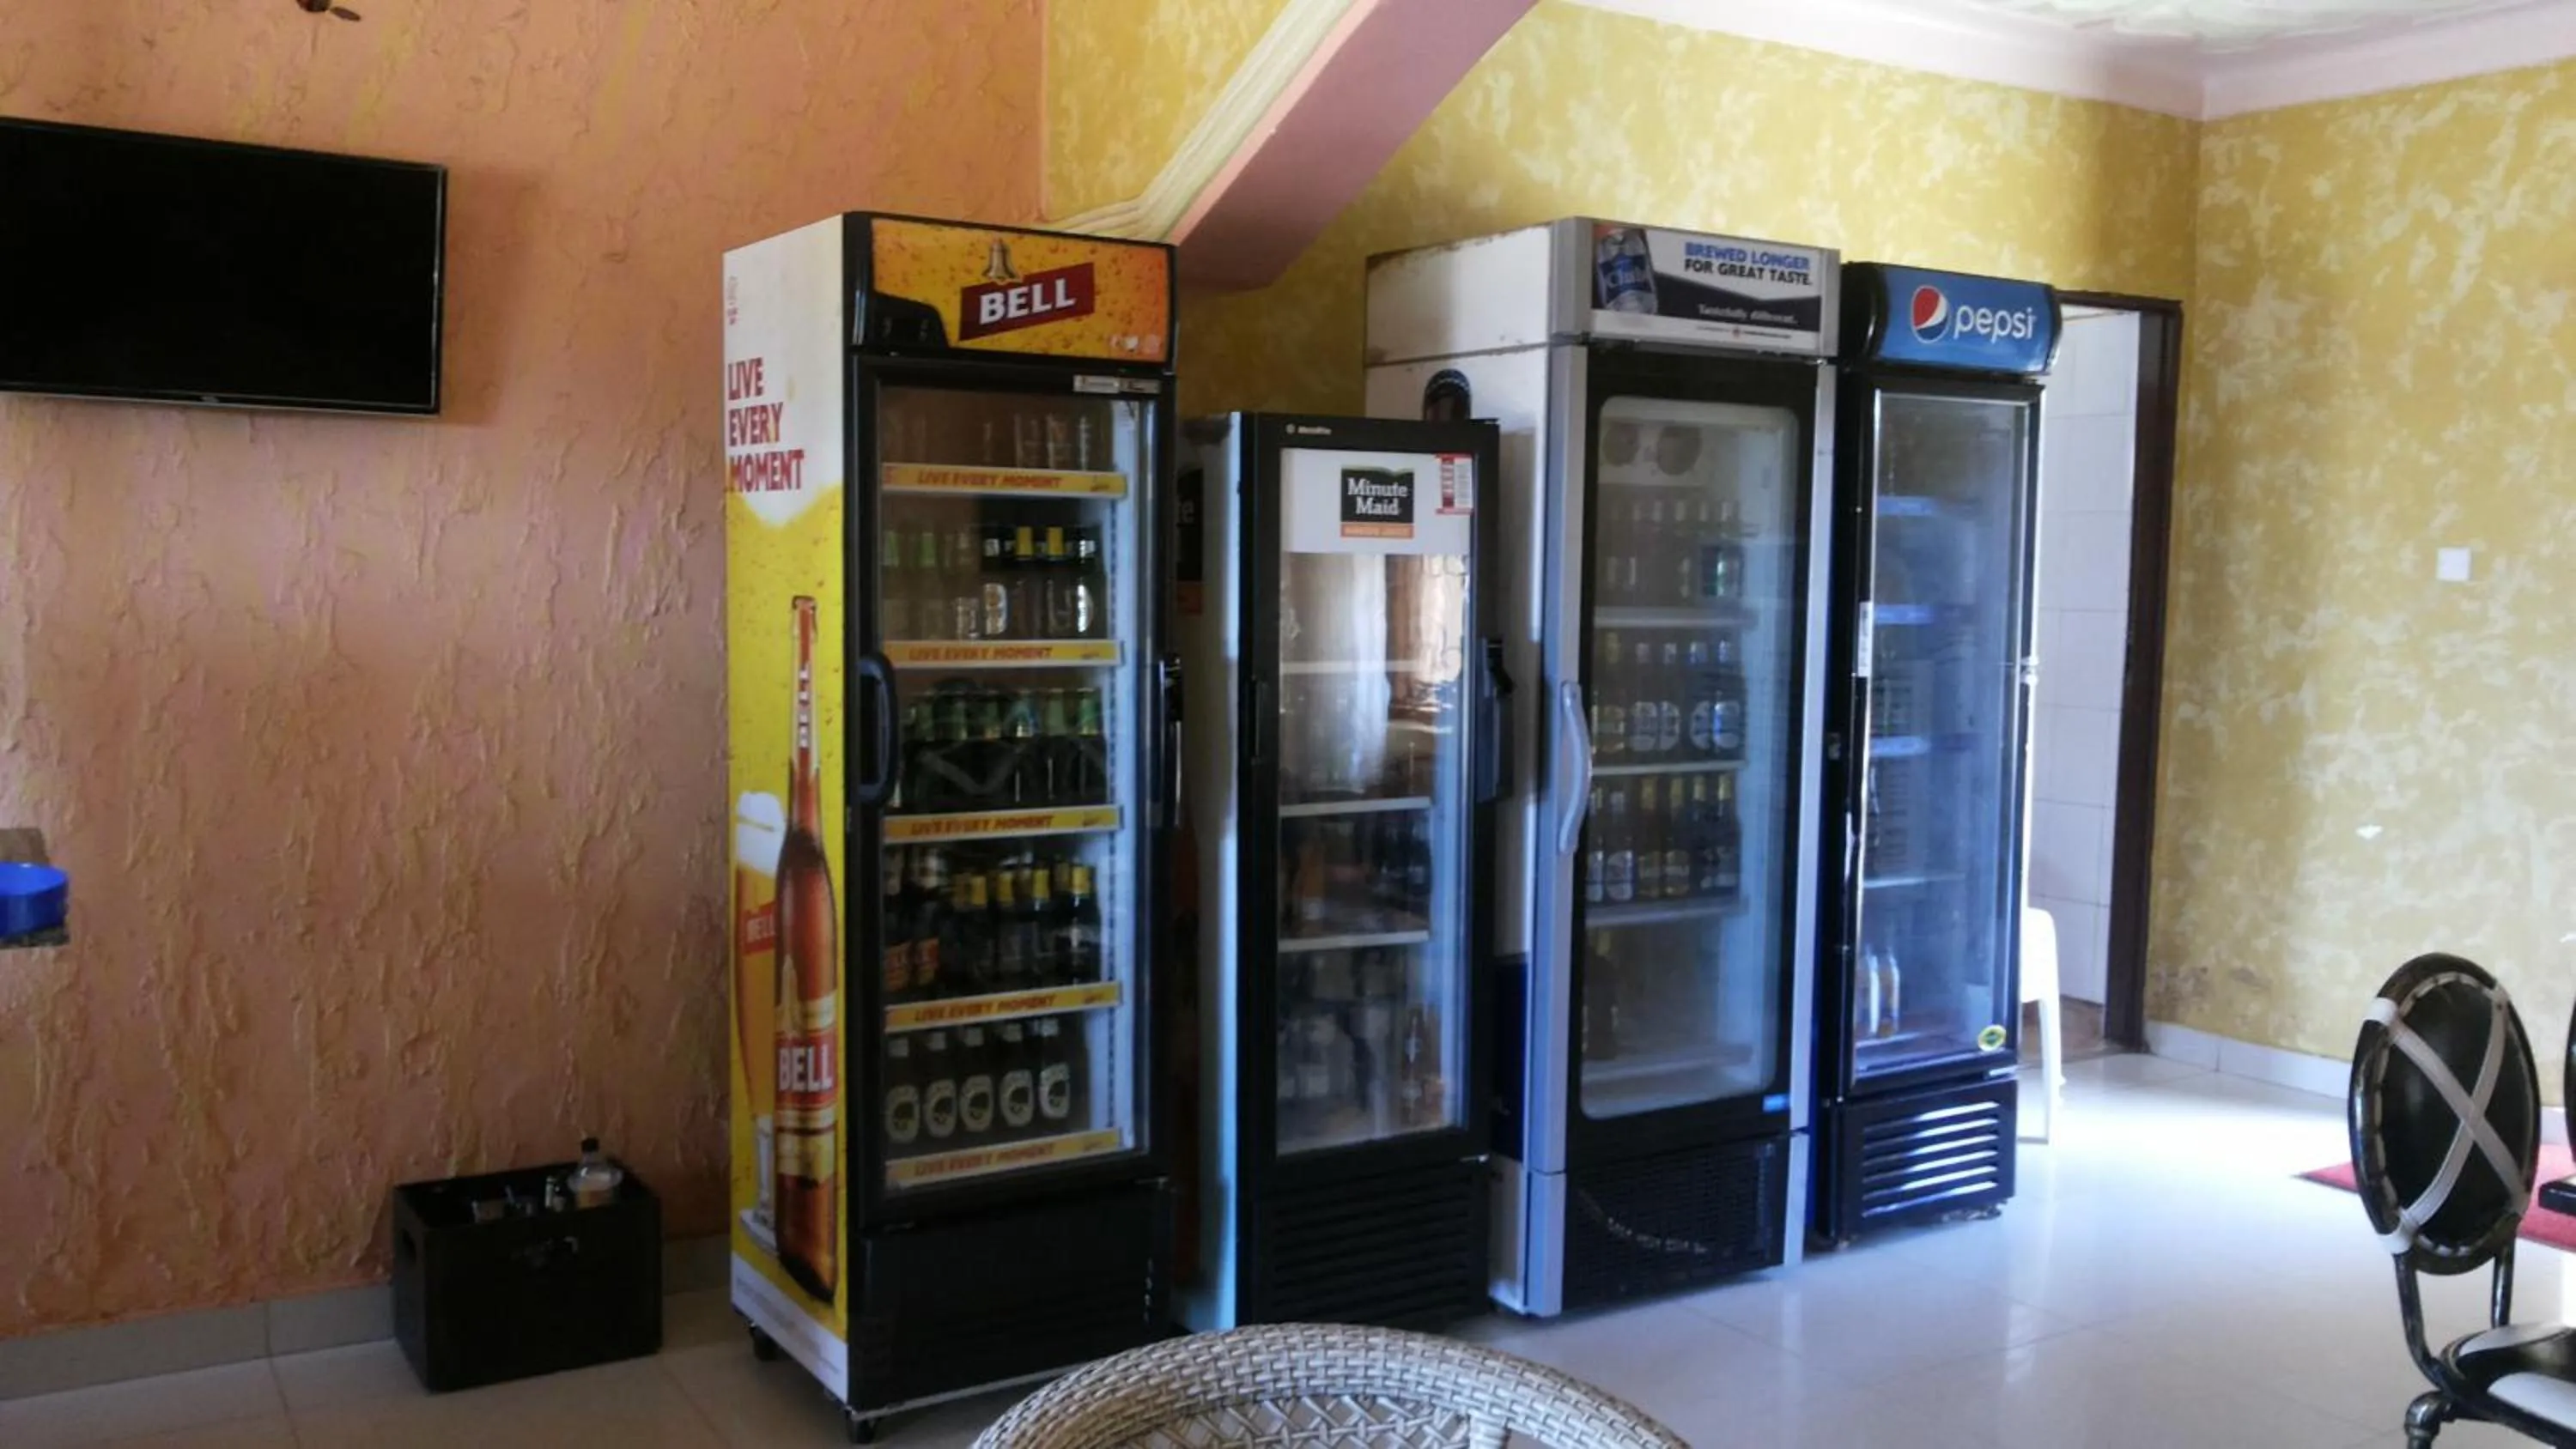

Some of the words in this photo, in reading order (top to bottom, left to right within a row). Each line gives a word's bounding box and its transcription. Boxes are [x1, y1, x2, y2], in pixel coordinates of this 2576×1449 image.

[1684, 242, 1747, 262] BREWED
[1752, 250, 1810, 270] LONGER
[1684, 258, 1713, 274] FOR
[1717, 262, 1765, 281] GREAT
[1769, 269, 1813, 286] TASTE.
[979, 277, 1077, 325] BELL
[1952, 304, 2036, 344] pepsi
[727, 357, 763, 401] LIVE
[728, 402, 784, 446] EVERY
[728, 449, 805, 493] MOMENT
[1347, 477, 1408, 497] Minute
[1356, 496, 1400, 516] Maid
[777, 1043, 834, 1093] BELL
